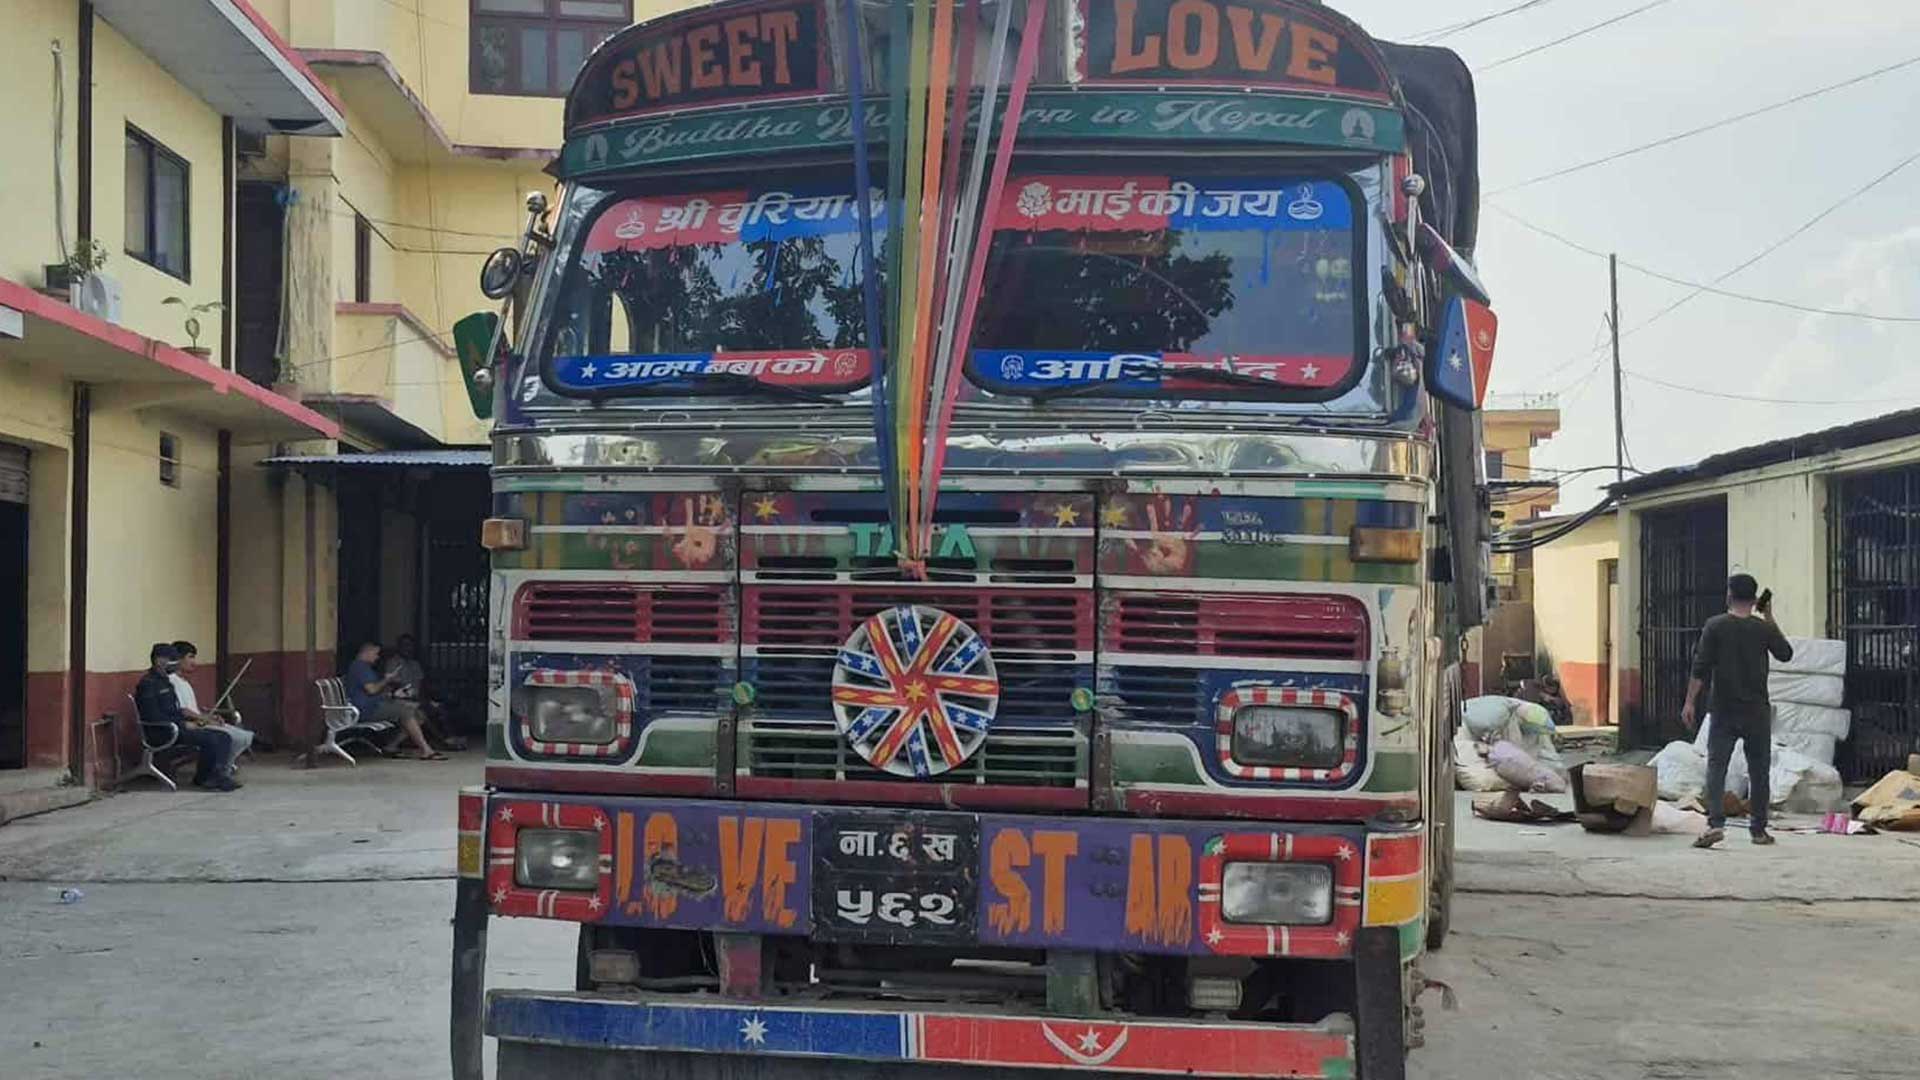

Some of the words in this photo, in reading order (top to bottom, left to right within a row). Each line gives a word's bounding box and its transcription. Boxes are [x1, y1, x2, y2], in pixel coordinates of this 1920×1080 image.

[611, 10, 799, 109] SWEET
[1110, 0, 1339, 85] LOVE
[620, 115, 803, 159] Buddha
[1090, 105, 1139, 124] in
[1149, 100, 1329, 132] Nepal
[654, 198, 714, 233] श्री
[1055, 181, 1138, 220] माई
[1138, 181, 1200, 217] की
[1201, 190, 1284, 218] जय
[848, 522, 976, 557] TAA
[836, 889, 957, 927] ५६२
